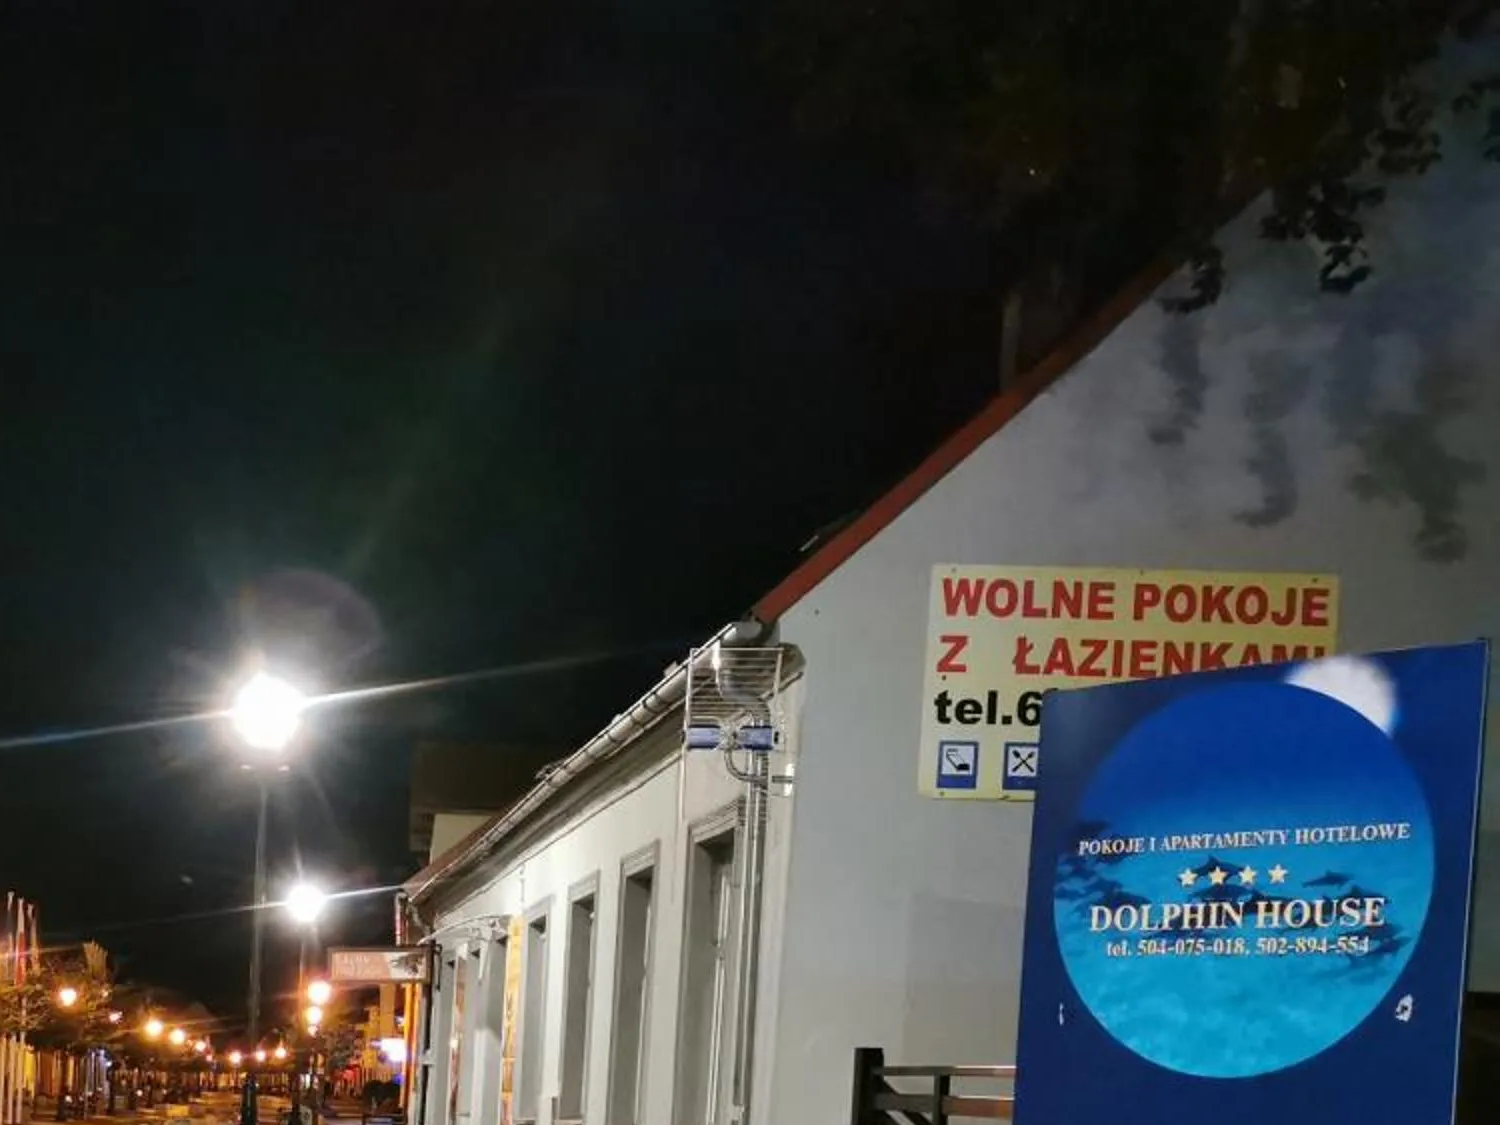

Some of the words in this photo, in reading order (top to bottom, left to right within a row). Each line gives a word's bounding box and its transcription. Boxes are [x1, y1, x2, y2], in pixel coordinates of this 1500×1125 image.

[942, 577, 1116, 620] WOLNE
[1132, 583, 1331, 627] POKOJE
[936, 635, 969, 673] Z
[934, 687, 1059, 727] tel.6
[1078, 837, 1145, 857] POKOJE
[1149, 837, 1157, 852] I
[1160, 829, 1288, 852] APARTAMENTY
[1294, 822, 1412, 846] HOTELOWE
[1090, 901, 1244, 932] DOLPHIN
[1256, 897, 1385, 928] HOUSE
[1106, 939, 1131, 957] tel.
